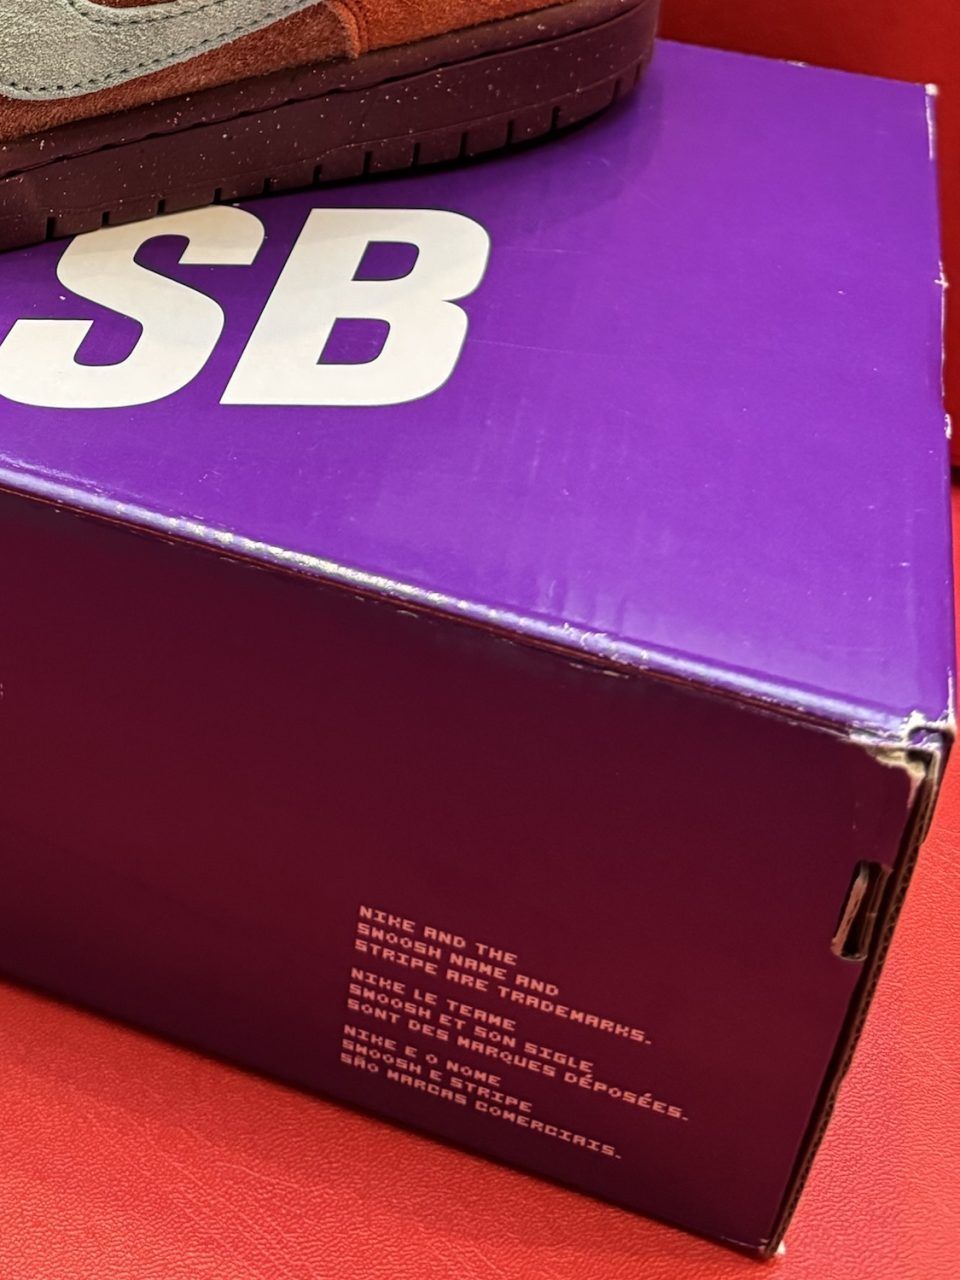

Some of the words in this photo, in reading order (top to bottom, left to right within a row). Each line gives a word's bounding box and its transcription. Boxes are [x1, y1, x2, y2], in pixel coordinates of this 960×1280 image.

[354, 938, 438, 975] STRIPE
[445, 968, 488, 991] ARE
[357, 922, 441, 959] SWOOSH
[449, 952, 507, 980] NAME
[515, 973, 558, 996] AND
[359, 905, 415, 932] NIKE
[423, 925, 466, 948] AND
[475, 942, 517, 965] THE
[350, 967, 405, 994] NIKE
[413, 988, 437, 1005] LE
[343, 1024, 396, 1050] NIKE
[404, 1045, 417, 1057] E
[425, 1053, 437, 1064] O
[446, 1060, 500, 1086] NOME
[347, 998, 400, 1023] SONT
[407, 1019, 448, 1041] DES
[456, 1035, 556, 1077] MARQUES
[349, 983, 430, 1019] SWOOSH
[440, 1014, 466, 1030] ET
[474, 1026, 516, 1048] SON
[524, 1042, 594, 1073] SIGLE
[342, 1038, 421, 1074] SWOOSH
[429, 1069, 442, 1081] E
[450, 1076, 532, 1112] STRIPE
[386, 1069, 466, 1105] MARCAS
